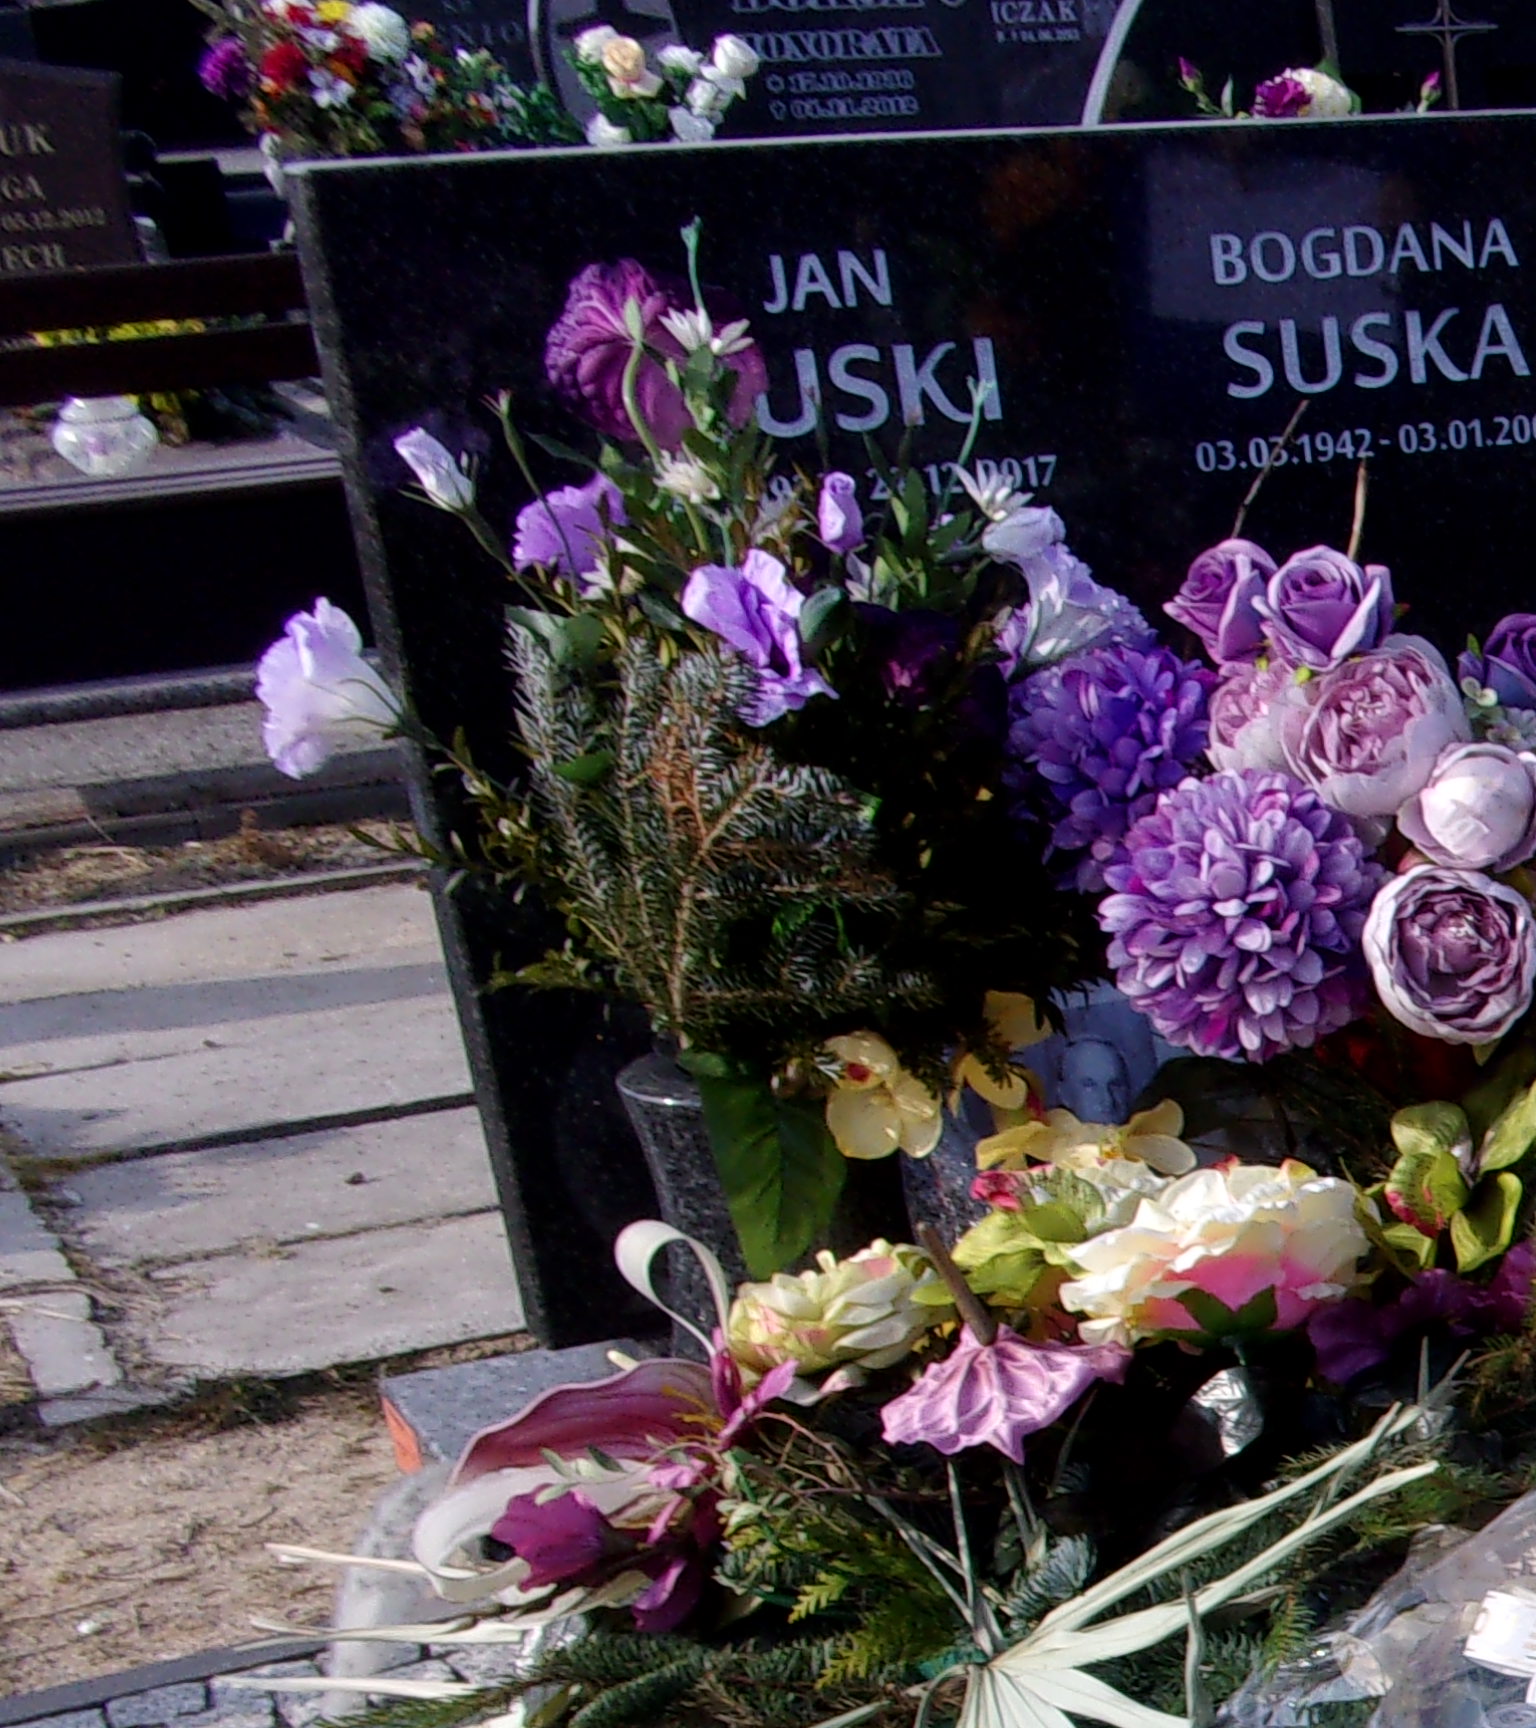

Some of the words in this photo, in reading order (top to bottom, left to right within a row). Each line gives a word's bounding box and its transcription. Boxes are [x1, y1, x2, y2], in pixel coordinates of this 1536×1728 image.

[763, 249, 893, 314] JAN
[1210, 218, 1519, 286] BOGDANA
[1222, 303, 1531, 399] SUSKA
[755, 336, 1003, 438] USKI
[1195, 428, 1374, 473] 03.03.1942
